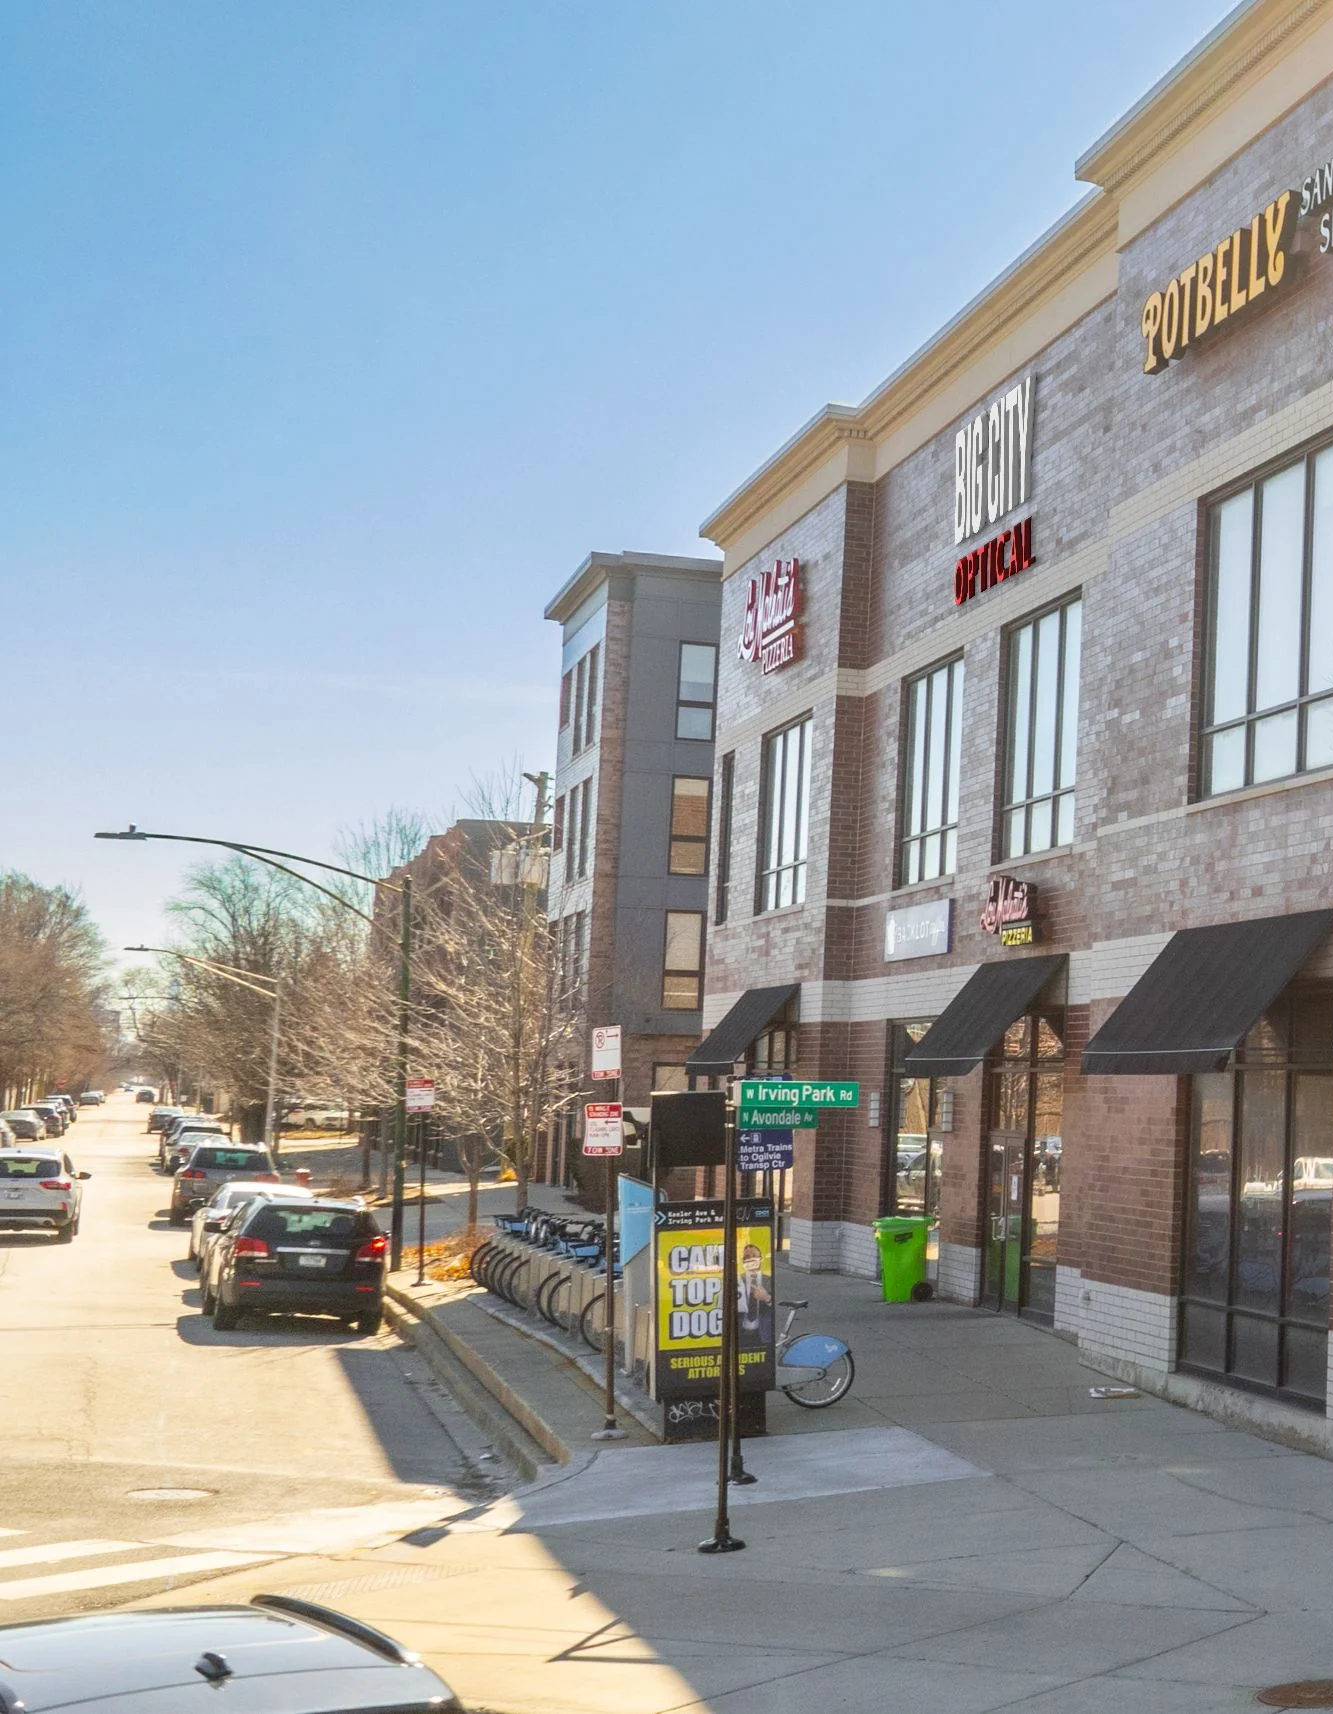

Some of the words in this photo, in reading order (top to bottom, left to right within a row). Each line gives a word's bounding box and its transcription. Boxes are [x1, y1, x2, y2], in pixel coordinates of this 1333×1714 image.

[1141, 190, 1291, 374] POTBELLY
[954, 416, 984, 547] BIG
[987, 375, 1032, 525] CITY
[953, 515, 1036, 607] OPTICAL
[761, 632, 794, 676] PIZZERIA
[1001, 925, 1033, 946] PIZZERIA
[746, 1088, 755, 1099] W
[758, 1084, 800, 1106] Irving
[802, 1084, 836, 1102] Park
[840, 1089, 853, 1101] Rd
[743, 1112, 749, 1122] N
[751, 1109, 802, 1125] Avondale
[804, 1112, 813, 1122] Av
[740, 1145, 765, 1154] Metra
[767, 1143, 793, 1152] Trains
[740, 1154, 749, 1162] to
[751, 1153, 782, 1163] Ogilvie
[741, 1161, 770, 1170] Transp
[771, 1160, 786, 1168] Ctr
[667, 1217, 692, 1225] Irving
[696, 1216, 712, 1224] Park
[714, 1215, 724, 1223] Rd
[696, 1209, 708, 1217] Ave
[669, 1277, 722, 1306] TOP
[670, 1308, 723, 1339] DOG
[670, 1355, 715, 1369] SERIOUS
[716, 1351, 767, 1366] AIDENT
[688, 1364, 746, 1379] ATTORS
